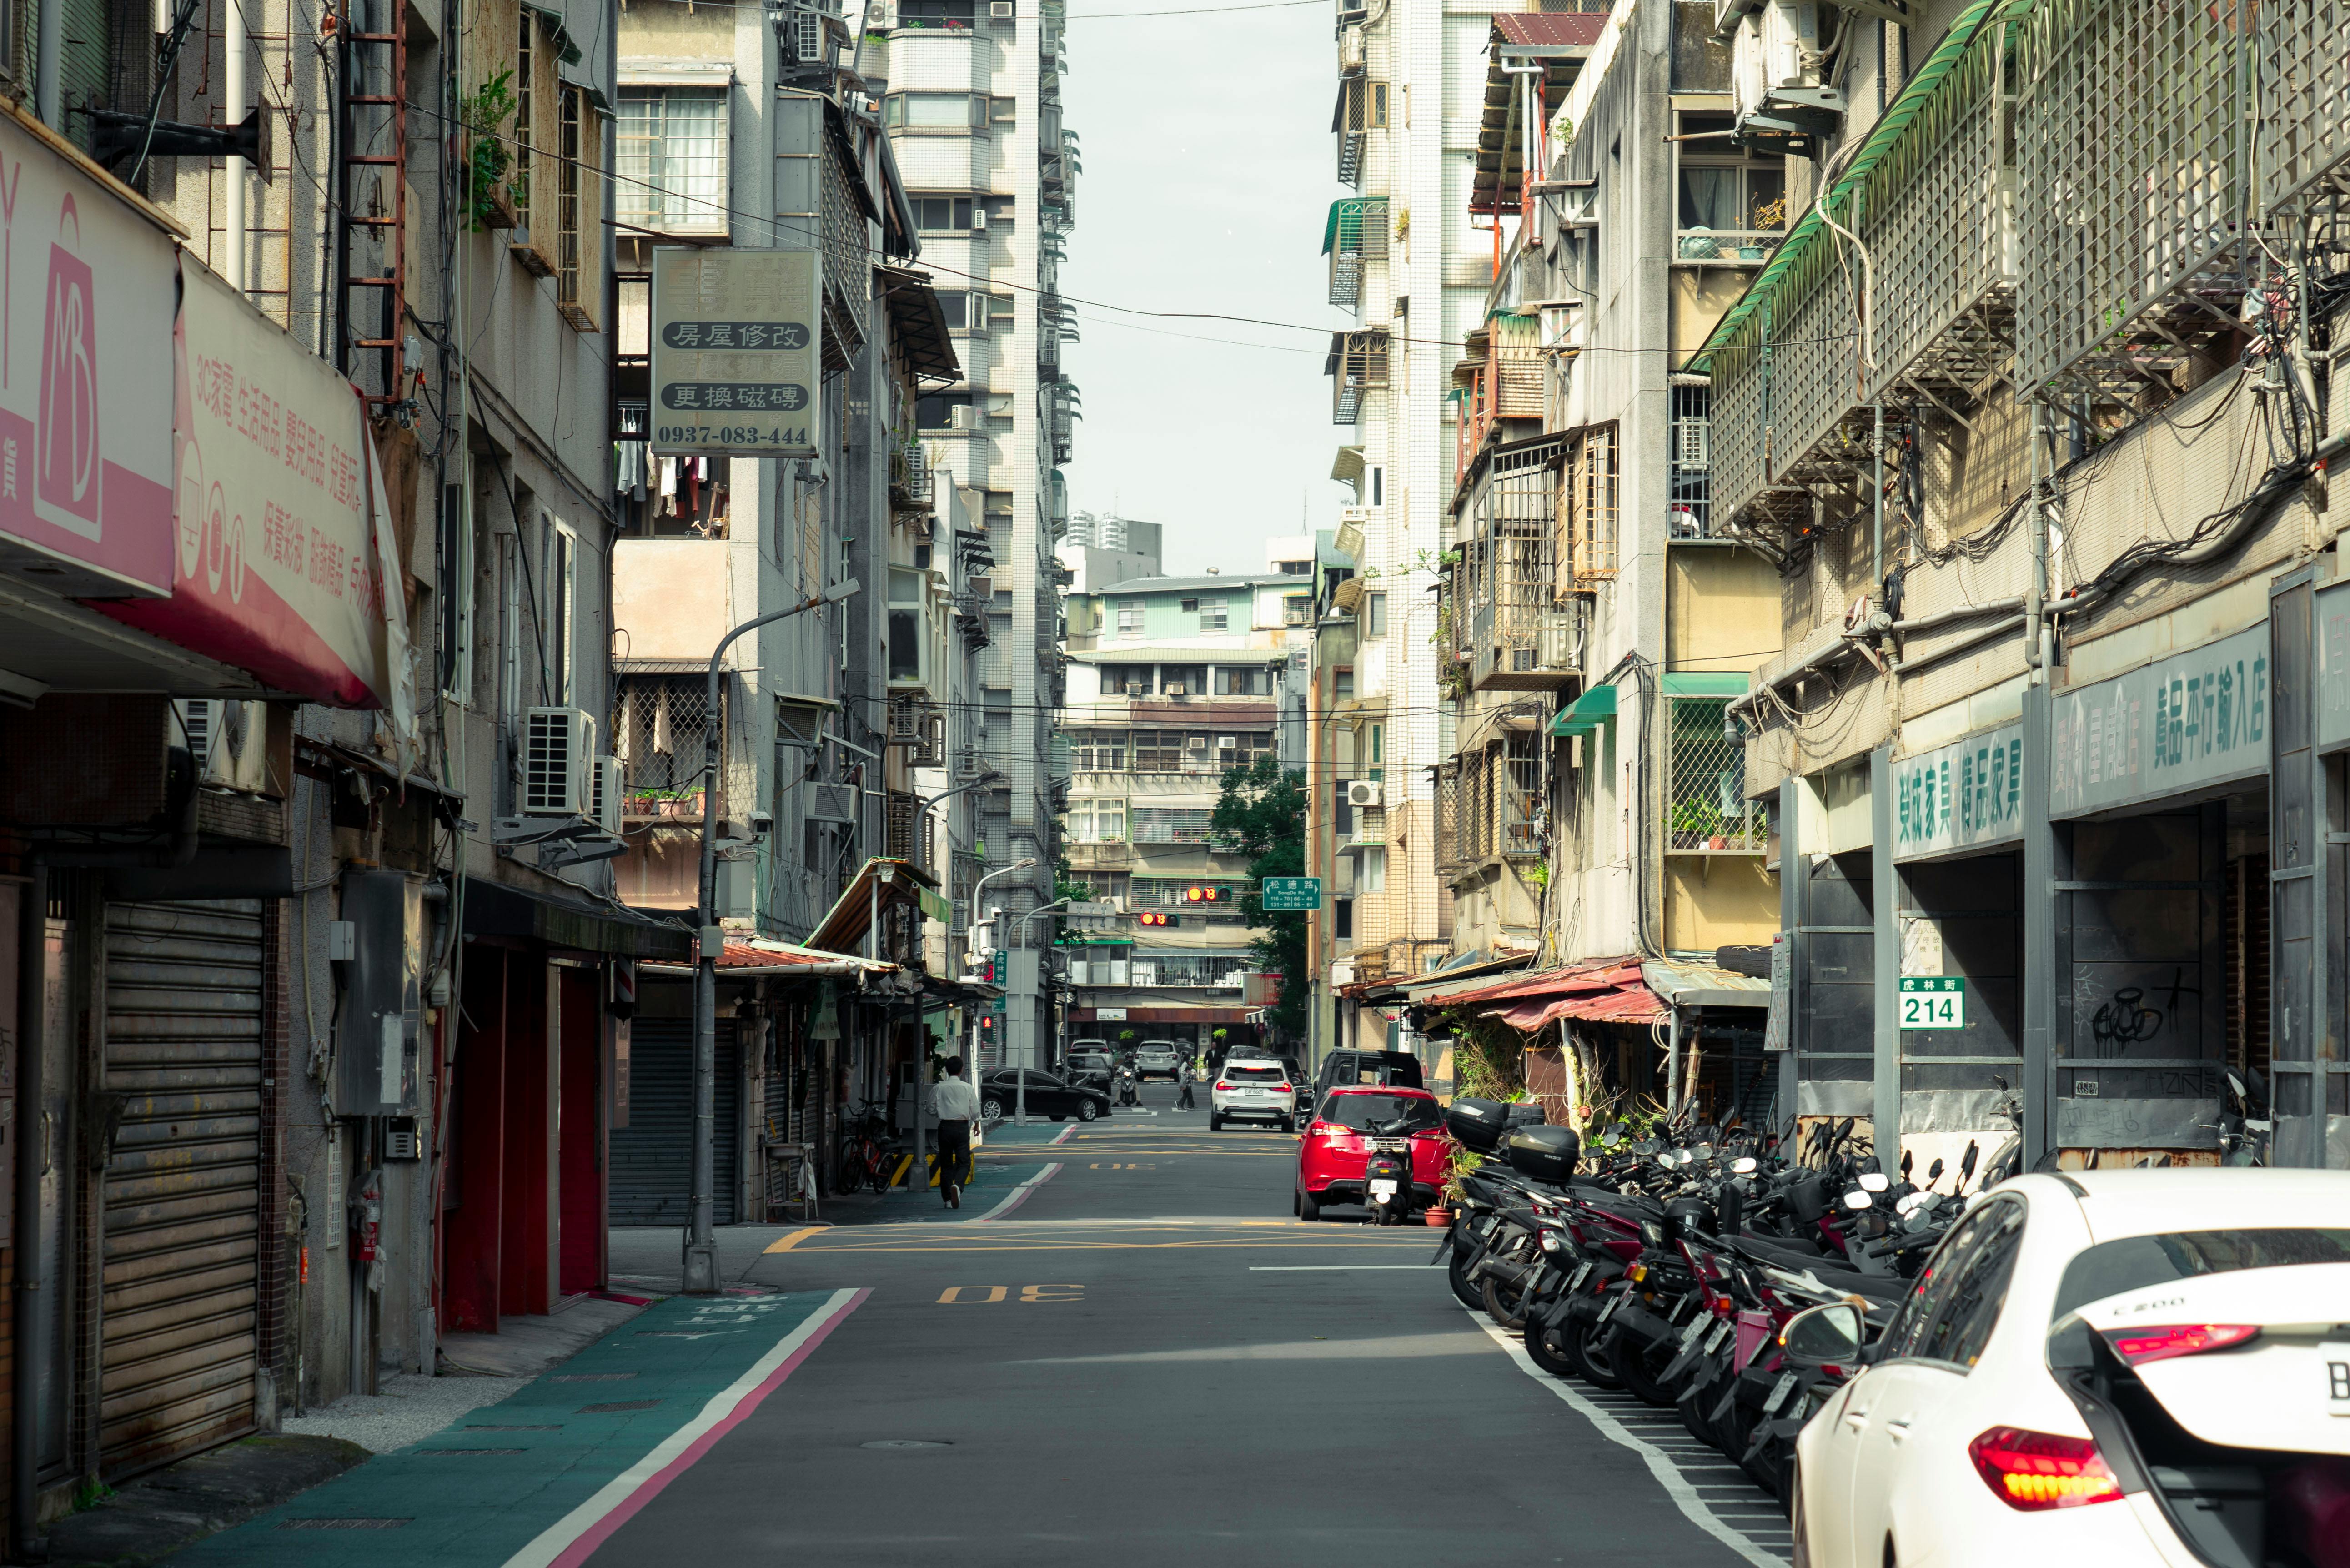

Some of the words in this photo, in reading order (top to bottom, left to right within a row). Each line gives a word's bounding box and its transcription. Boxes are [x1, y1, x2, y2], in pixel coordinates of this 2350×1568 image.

[672, 324, 801, 347] 房屋修改
[673, 386, 800, 408] 更換磁磚
[196, 354, 233, 427] 3C家電
[237, 376, 280, 459] 生活用品
[285, 409, 325, 490] 嬰兒用品
[329, 442, 362, 514] 兒童玩
[658, 426, 807, 445] 0937-083-444
[263, 498, 305, 576] 保養彩妝
[309, 526, 344, 600] 服飾精品
[1961, 739, 2021, 834] 精品家具
[1270, 880, 1314, 890] 松德路
[996, 956, 1004, 981] 虎林街
[1903, 979, 1955, 990] 虎林街
[1905, 998, 1954, 1022] 214
